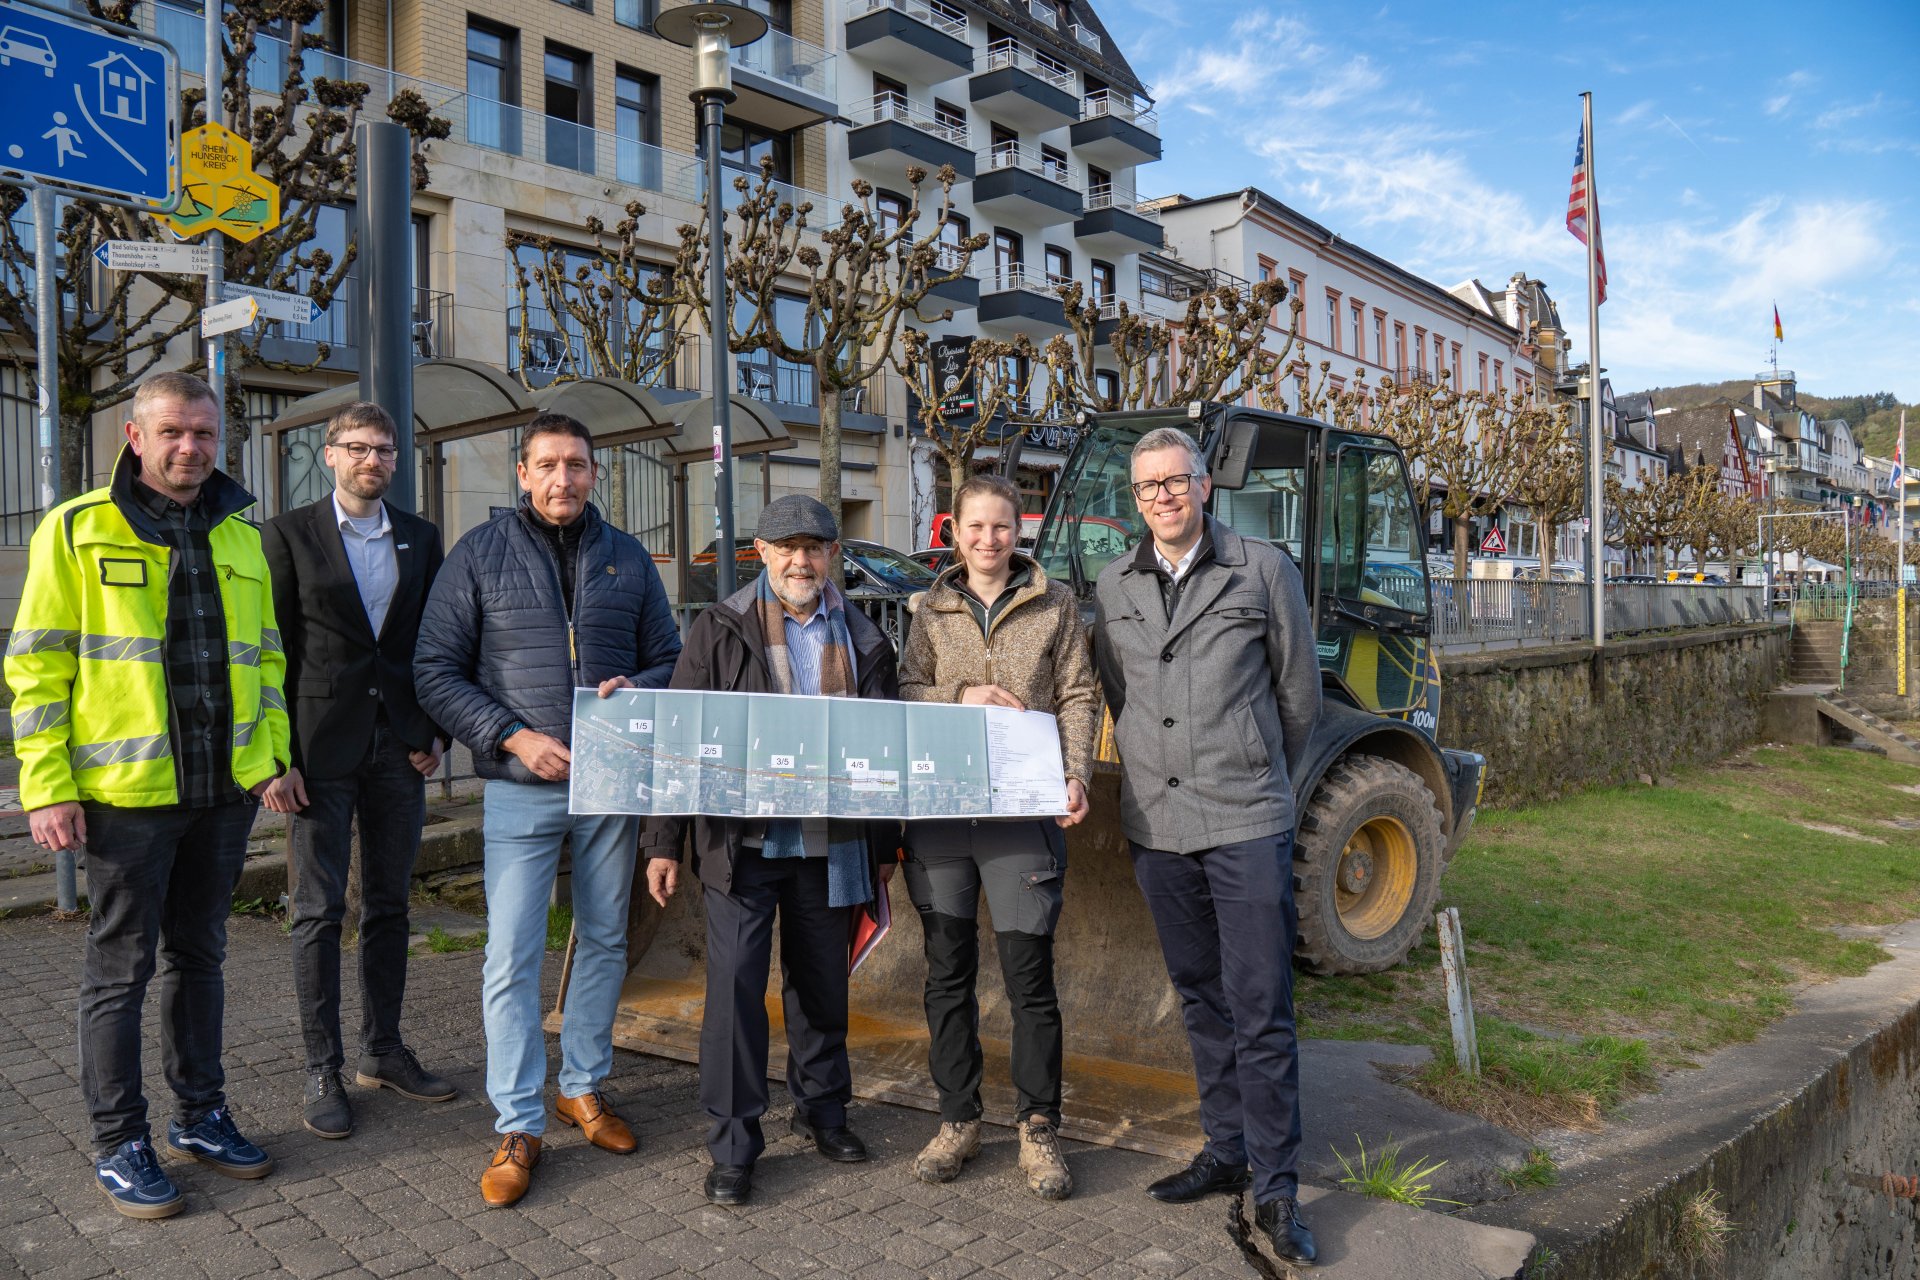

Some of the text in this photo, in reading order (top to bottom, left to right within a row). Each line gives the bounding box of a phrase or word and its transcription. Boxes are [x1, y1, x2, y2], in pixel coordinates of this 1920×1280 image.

[202, 144, 228, 154] RHEIN
[203, 161, 227, 170] KREIS
[123, 244, 138, 252] Salzig
[943, 393, 969, 403] STAURANT
[941, 407, 964, 415] PIZZERIA
[1412, 709, 1436, 729] 100M
[634, 722, 648, 730] 1/5
[704, 746, 717, 755] 2/5
[776, 757, 790, 766] 3/5
[850, 761, 864, 769] 4/5
[917, 763, 930, 771] 5/5
